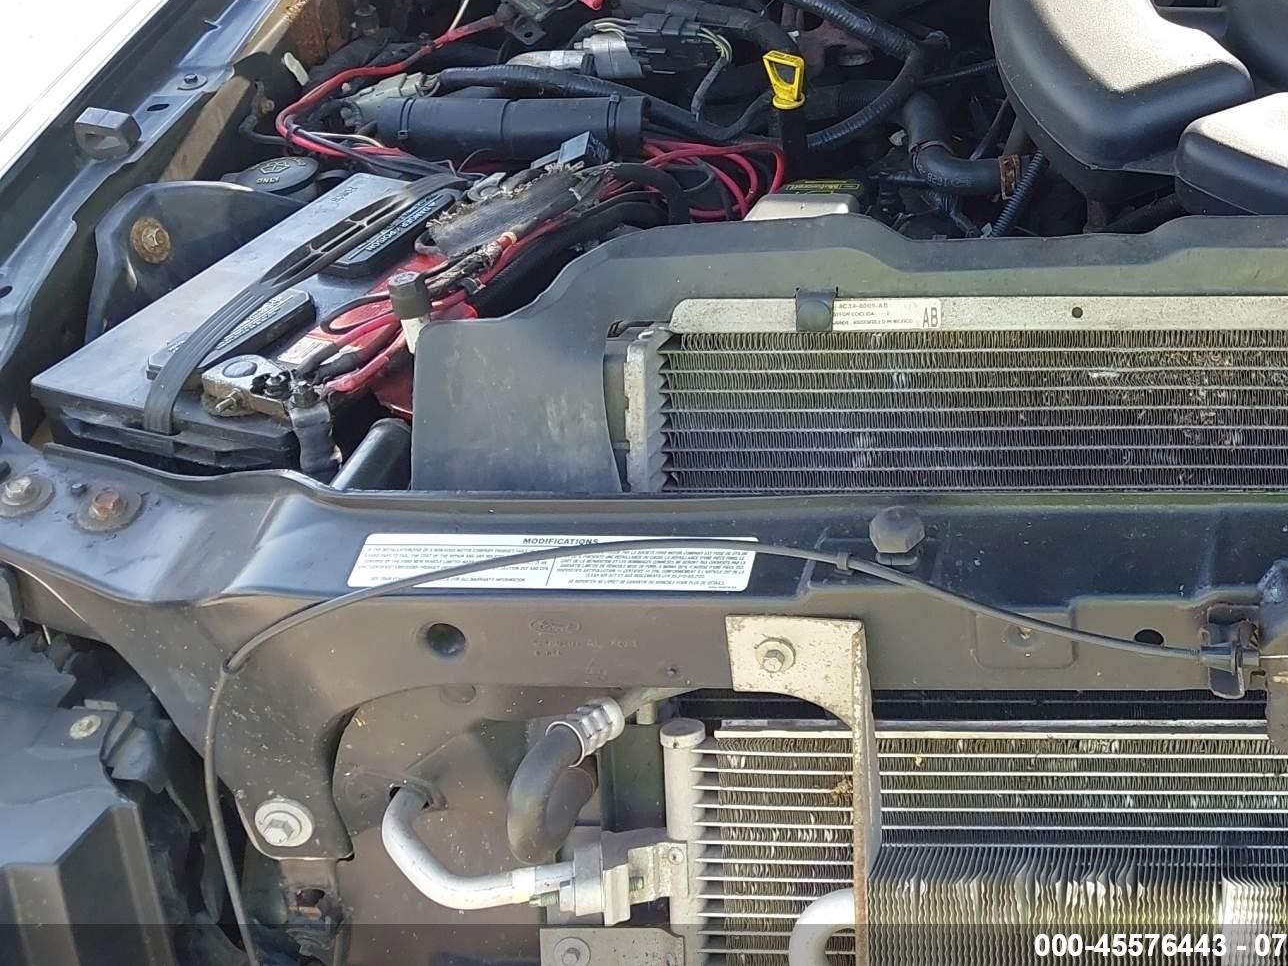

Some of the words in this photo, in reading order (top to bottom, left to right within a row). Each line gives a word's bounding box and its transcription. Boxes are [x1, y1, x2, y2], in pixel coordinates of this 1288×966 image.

[399, 205, 431, 230] DANGER
[365, 230, 397, 253] POISON
[922, 306, 939, 328] AB
[522, 537, 599, 546] MODIFICATIONS
